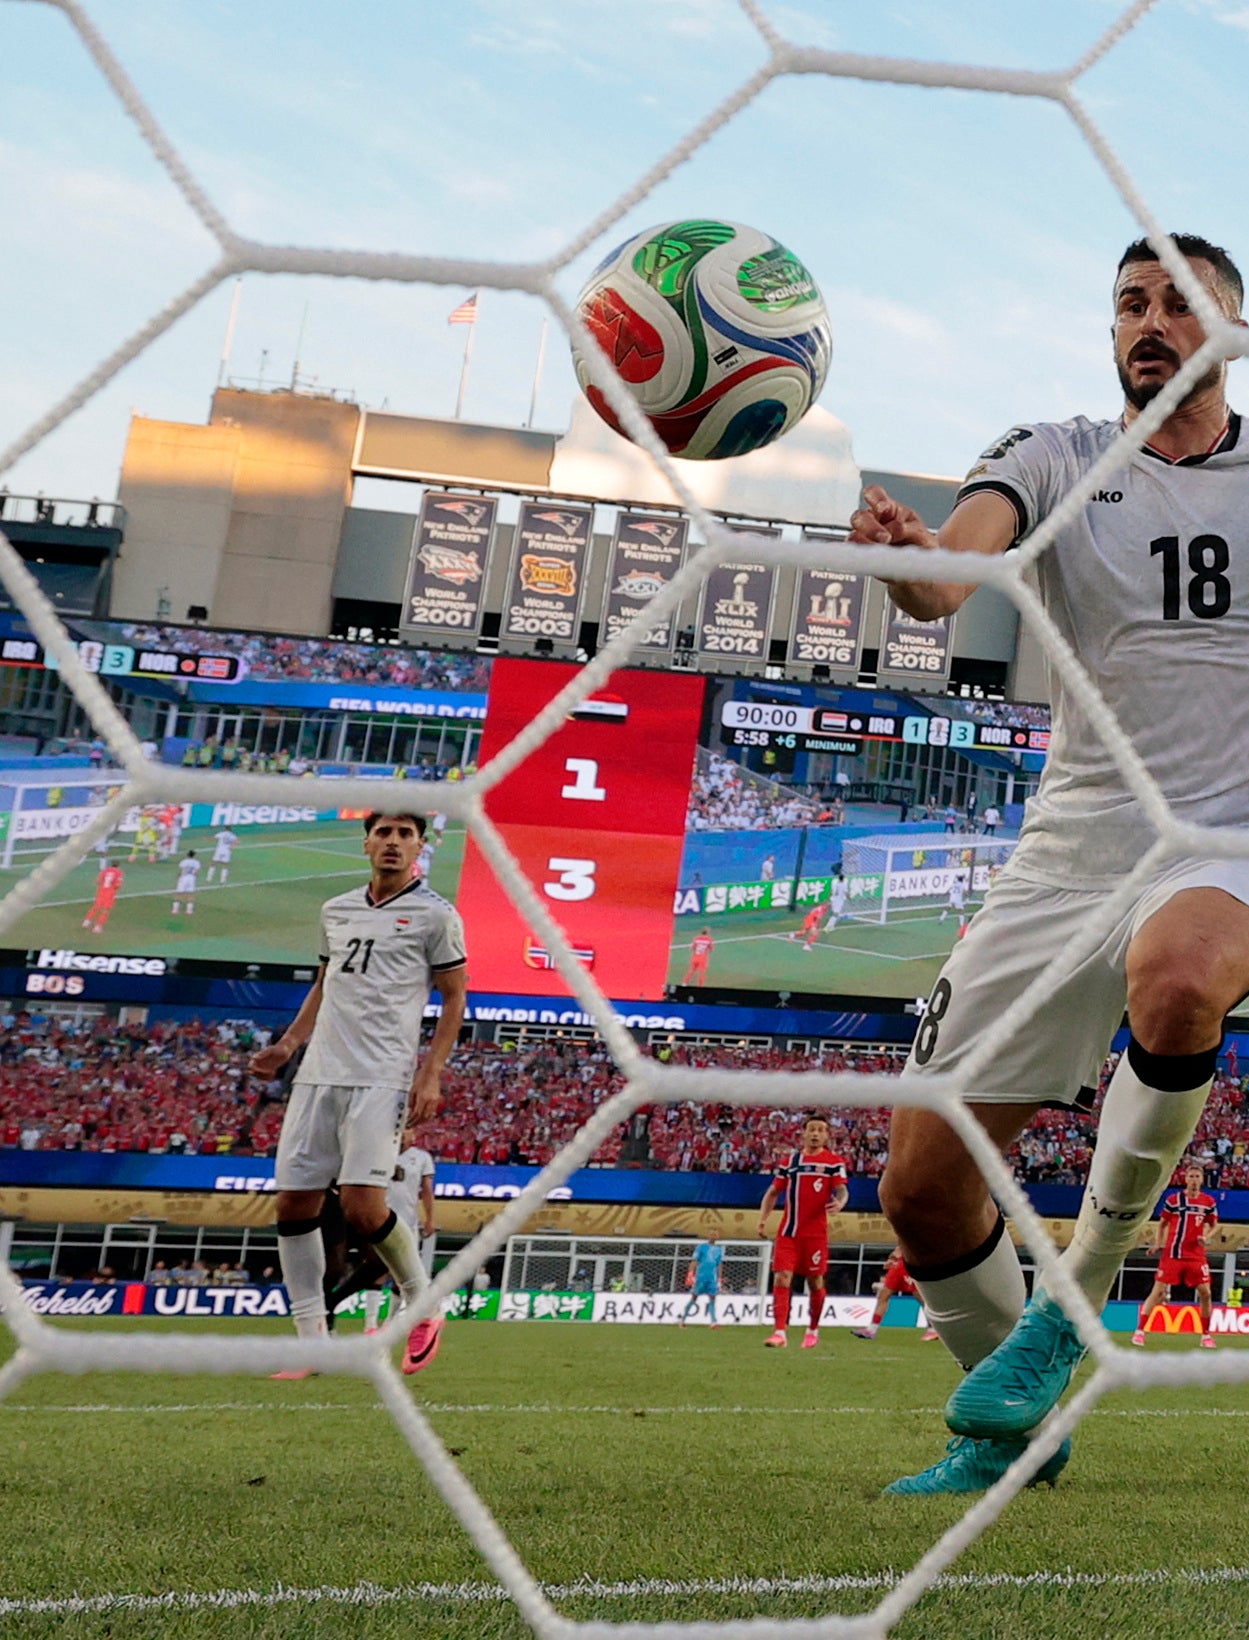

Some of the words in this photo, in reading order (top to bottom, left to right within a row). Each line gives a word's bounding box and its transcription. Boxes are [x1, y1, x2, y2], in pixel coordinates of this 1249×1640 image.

[423, 521, 445, 531] NEW
[447, 523, 489, 535] ENGLAND
[430, 530, 481, 543] PATRIOTS
[521, 532, 543, 541] NEW
[544, 533, 586, 545] ENGLAND
[528, 540, 577, 553] PATRIOTS
[618, 541, 639, 549] NEW
[641, 543, 681, 555] ENGLAND
[624, 550, 673, 563] PATRIOTS
[810, 570, 857, 582] PATRIOTS
[1150, 534, 1231, 620] 18
[424, 587, 467, 600] WORLD
[411, 597, 477, 611] CHAMPIONS
[523, 597, 565, 610] WORLD
[714, 602, 758, 617] XLIX
[411, 608, 473, 626] 2001
[510, 606, 574, 621] CHAMPIONS
[715, 616, 755, 628] WORLD
[508, 617, 572, 636] 2003
[703, 624, 764, 639] CHAMPIONS
[808, 624, 847, 637] WORLD
[704, 635, 760, 653] 2014
[796, 633, 856, 648] CHAMPIONS
[899, 633, 936, 646] WORLD
[798, 644, 851, 663] 2016
[887, 642, 945, 657] CHAMPIONS
[109, 651, 124, 668] 3
[138, 652, 179, 673] NOR
[889, 653, 941, 670] 2018
[329, 697, 373, 712] FIFA
[736, 706, 798, 727] 90:00
[868, 716, 895, 735] IRQ
[911, 722, 919, 737] 1
[956, 727, 968, 742] 3
[980, 727, 1011, 745] NOR
[733, 730, 769, 746] 5:58
[775, 734, 797, 748] +6
[805, 739, 856, 752] MINIMUM
[561, 758, 606, 801] 1
[16, 814, 61, 832] BANK
[69, 813, 90, 829] OF
[211, 802, 317, 827] Hisense
[543, 857, 597, 902] 3
[888, 876, 928, 893] BANK
[932, 875, 949, 888] OF
[728, 885, 766, 909] 蒙牛
[37, 949, 167, 976] Hisense
[341, 938, 375, 974] 21
[25, 974, 85, 995] BOS
[475, 1006, 558, 1024] WORLD
[813, 1178, 823, 1192] 6
[812, 1250, 822, 1265] 6
[154, 1288, 289, 1316] ULTRA
[533, 1293, 587, 1319] 蒙牛
[604, 1301, 673, 1318] BANK
[723, 1303, 837, 1319] AMEIA
